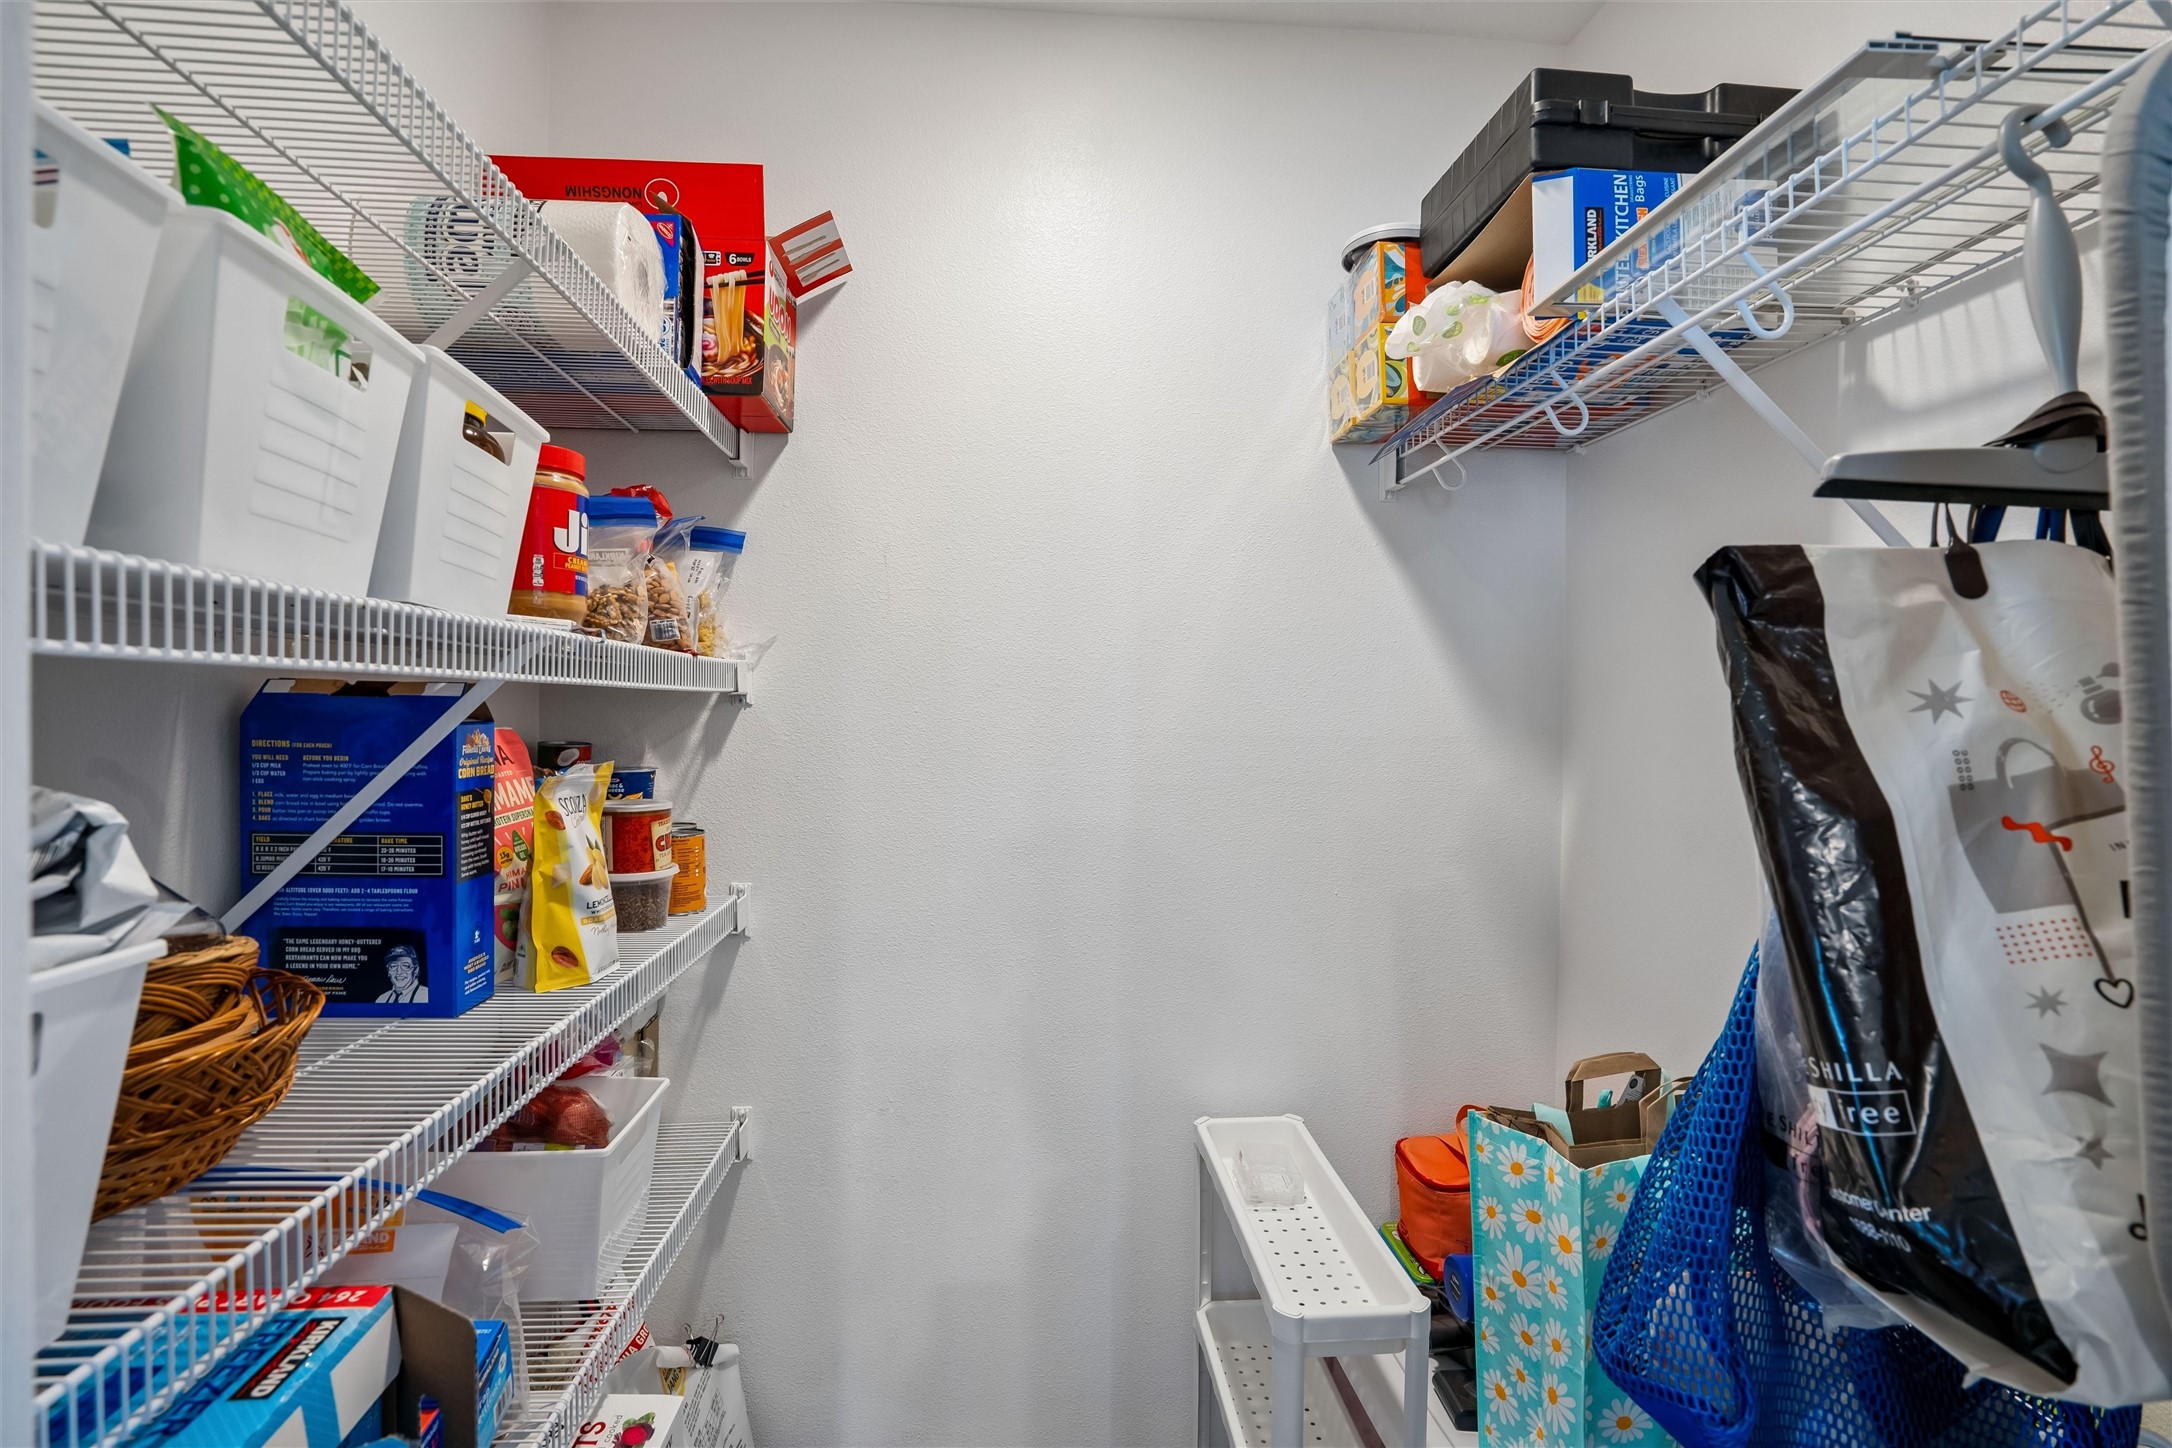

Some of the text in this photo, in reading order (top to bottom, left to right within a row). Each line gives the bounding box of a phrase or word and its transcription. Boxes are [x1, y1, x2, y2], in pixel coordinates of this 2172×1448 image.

[565, 185, 642, 198] NONGSHIM
[1635, 175, 1646, 202] Bags
[1587, 208, 1597, 259] RKLAND
[729, 254, 737, 264] 6
[742, 376, 752, 384] MIX
[554, 509, 588, 554] Ji
[251, 739, 290, 747] DIRECTIONS
[458, 764, 494, 779] CORN BREAD
[505, 867, 527, 880] HIMA
[1808, 1056, 1903, 1082] SHILLA
[322, 1290, 367, 1305] 264
[252, 1319, 341, 1399] KIRKLAND
[604, 1414, 623, 1443] cooked
